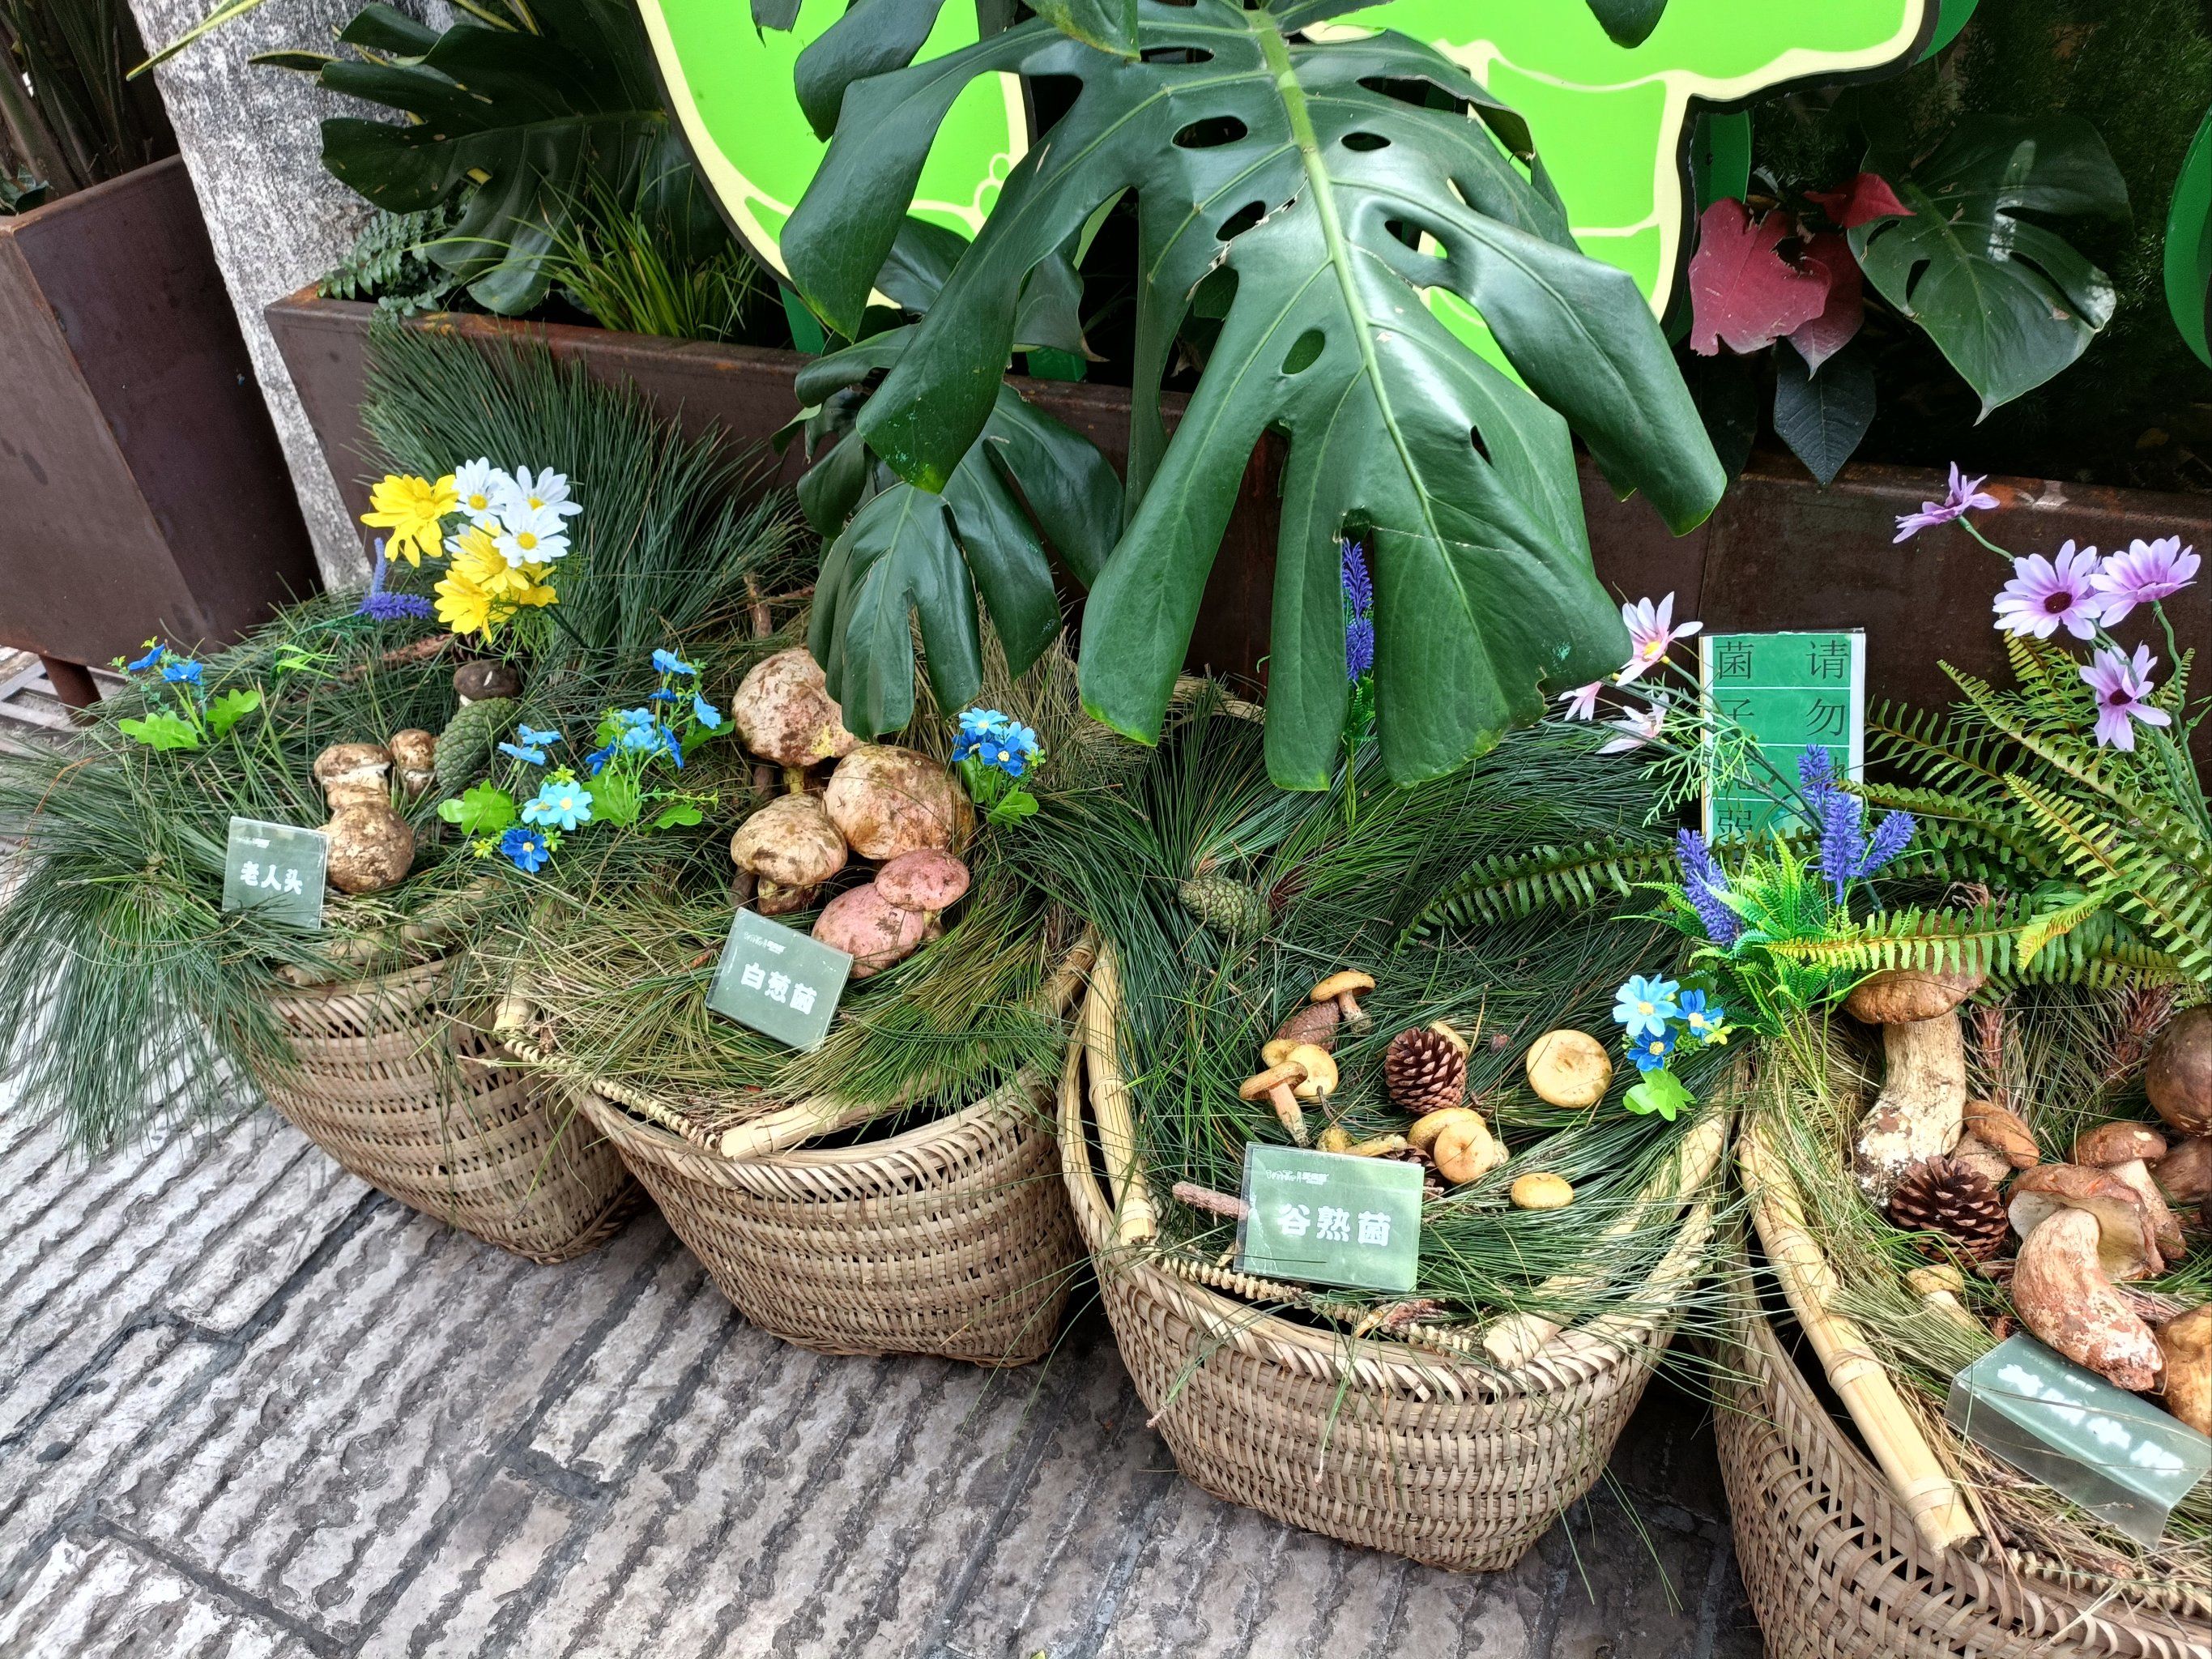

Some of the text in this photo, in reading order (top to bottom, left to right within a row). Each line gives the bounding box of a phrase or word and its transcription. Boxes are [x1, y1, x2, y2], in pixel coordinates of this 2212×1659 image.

[240, 860, 303, 895] 老人头
[740, 962, 818, 1015] 白葱菌
[1276, 1202, 1392, 1247] 谷熟菌
